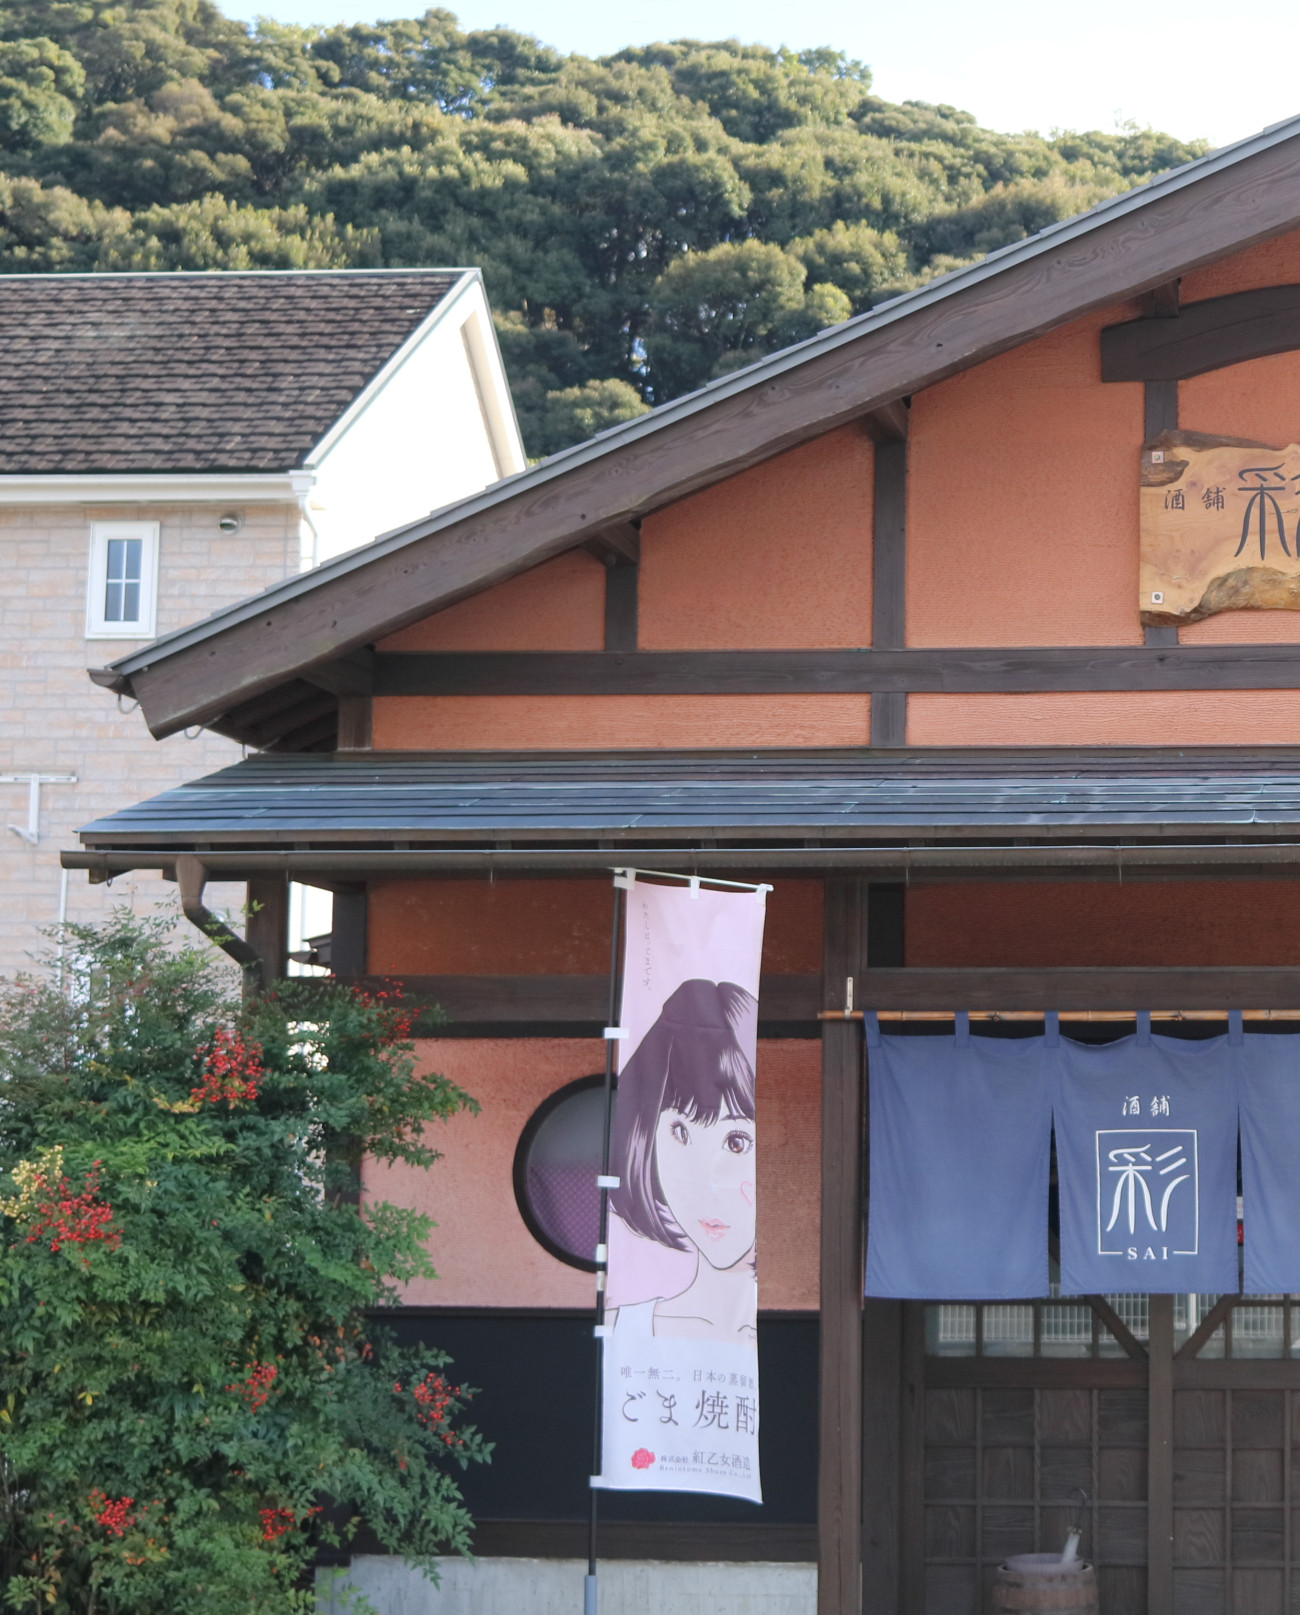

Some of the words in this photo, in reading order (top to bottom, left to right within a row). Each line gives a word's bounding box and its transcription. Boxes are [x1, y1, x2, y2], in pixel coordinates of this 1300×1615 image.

[1163, 487, 1226, 511] 酒舗
[1122, 1095, 1171, 1117] 酒舗
[1106, 1143, 1190, 1235] 彩
[1127, 1246, 1169, 1260] SAI
[622, 1389, 757, 1436] ごま焼酎
[693, 1450, 751, 1470] 紅乙女酒造
